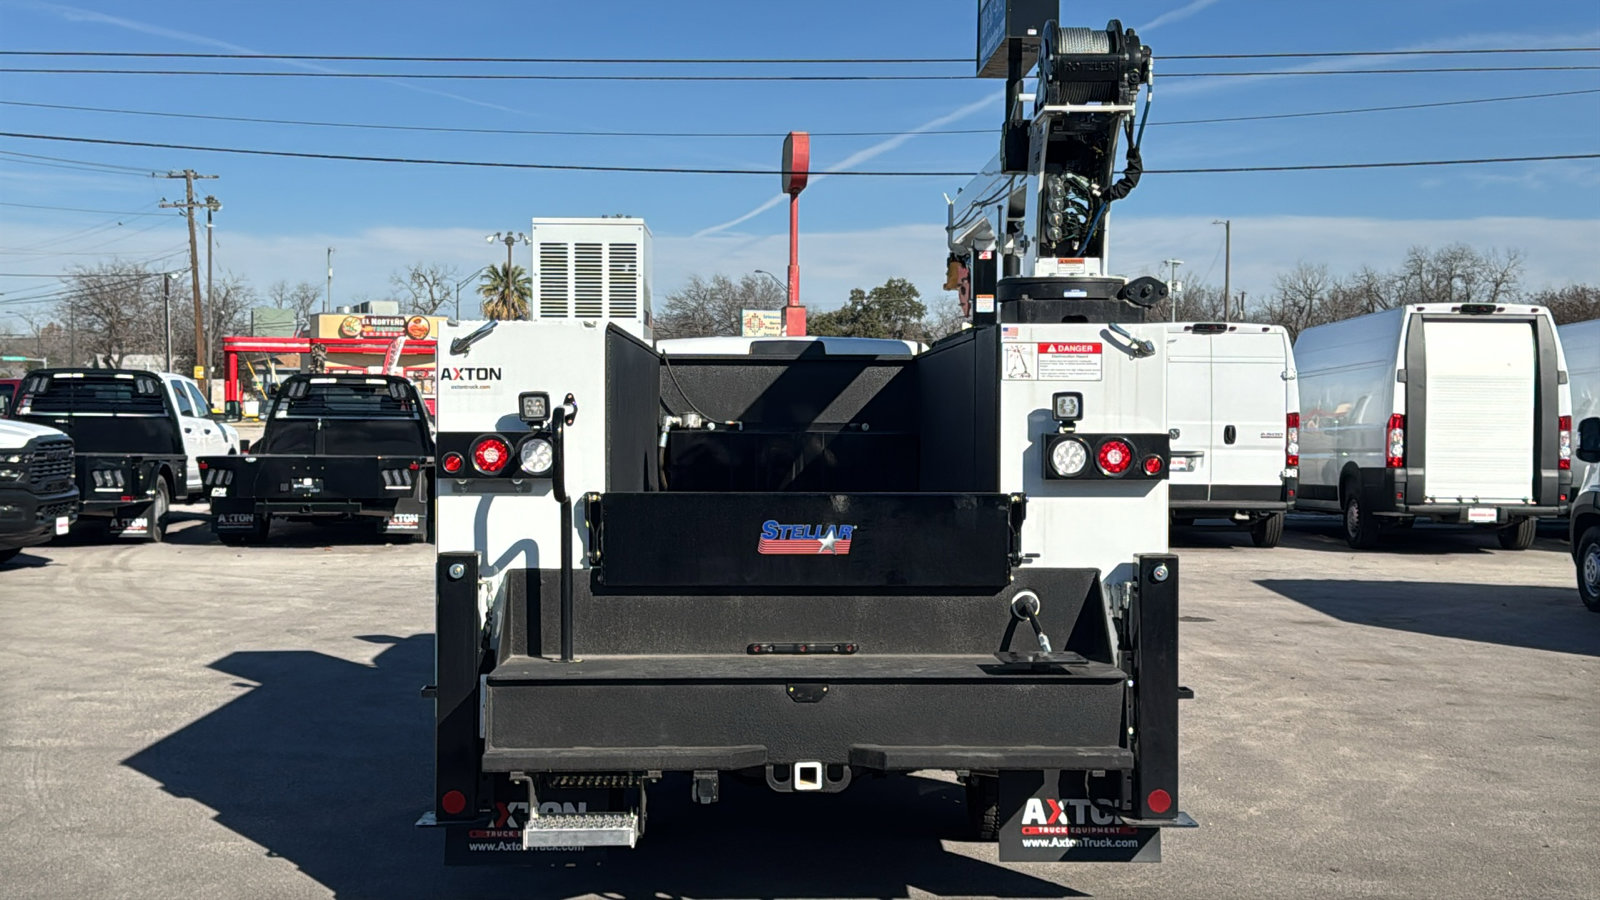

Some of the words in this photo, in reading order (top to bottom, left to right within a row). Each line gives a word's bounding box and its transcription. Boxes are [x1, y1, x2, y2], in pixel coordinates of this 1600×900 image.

[1057, 344, 1093, 352] DANGER
[440, 367, 502, 381] AXTON
[760, 519, 854, 540] STELLAR
[1038, 826, 1068, 834] TRUCK
[1070, 826, 1121, 834] EQUIPMENT
[1021, 836, 1139, 849] www.AxtonTruck.com
